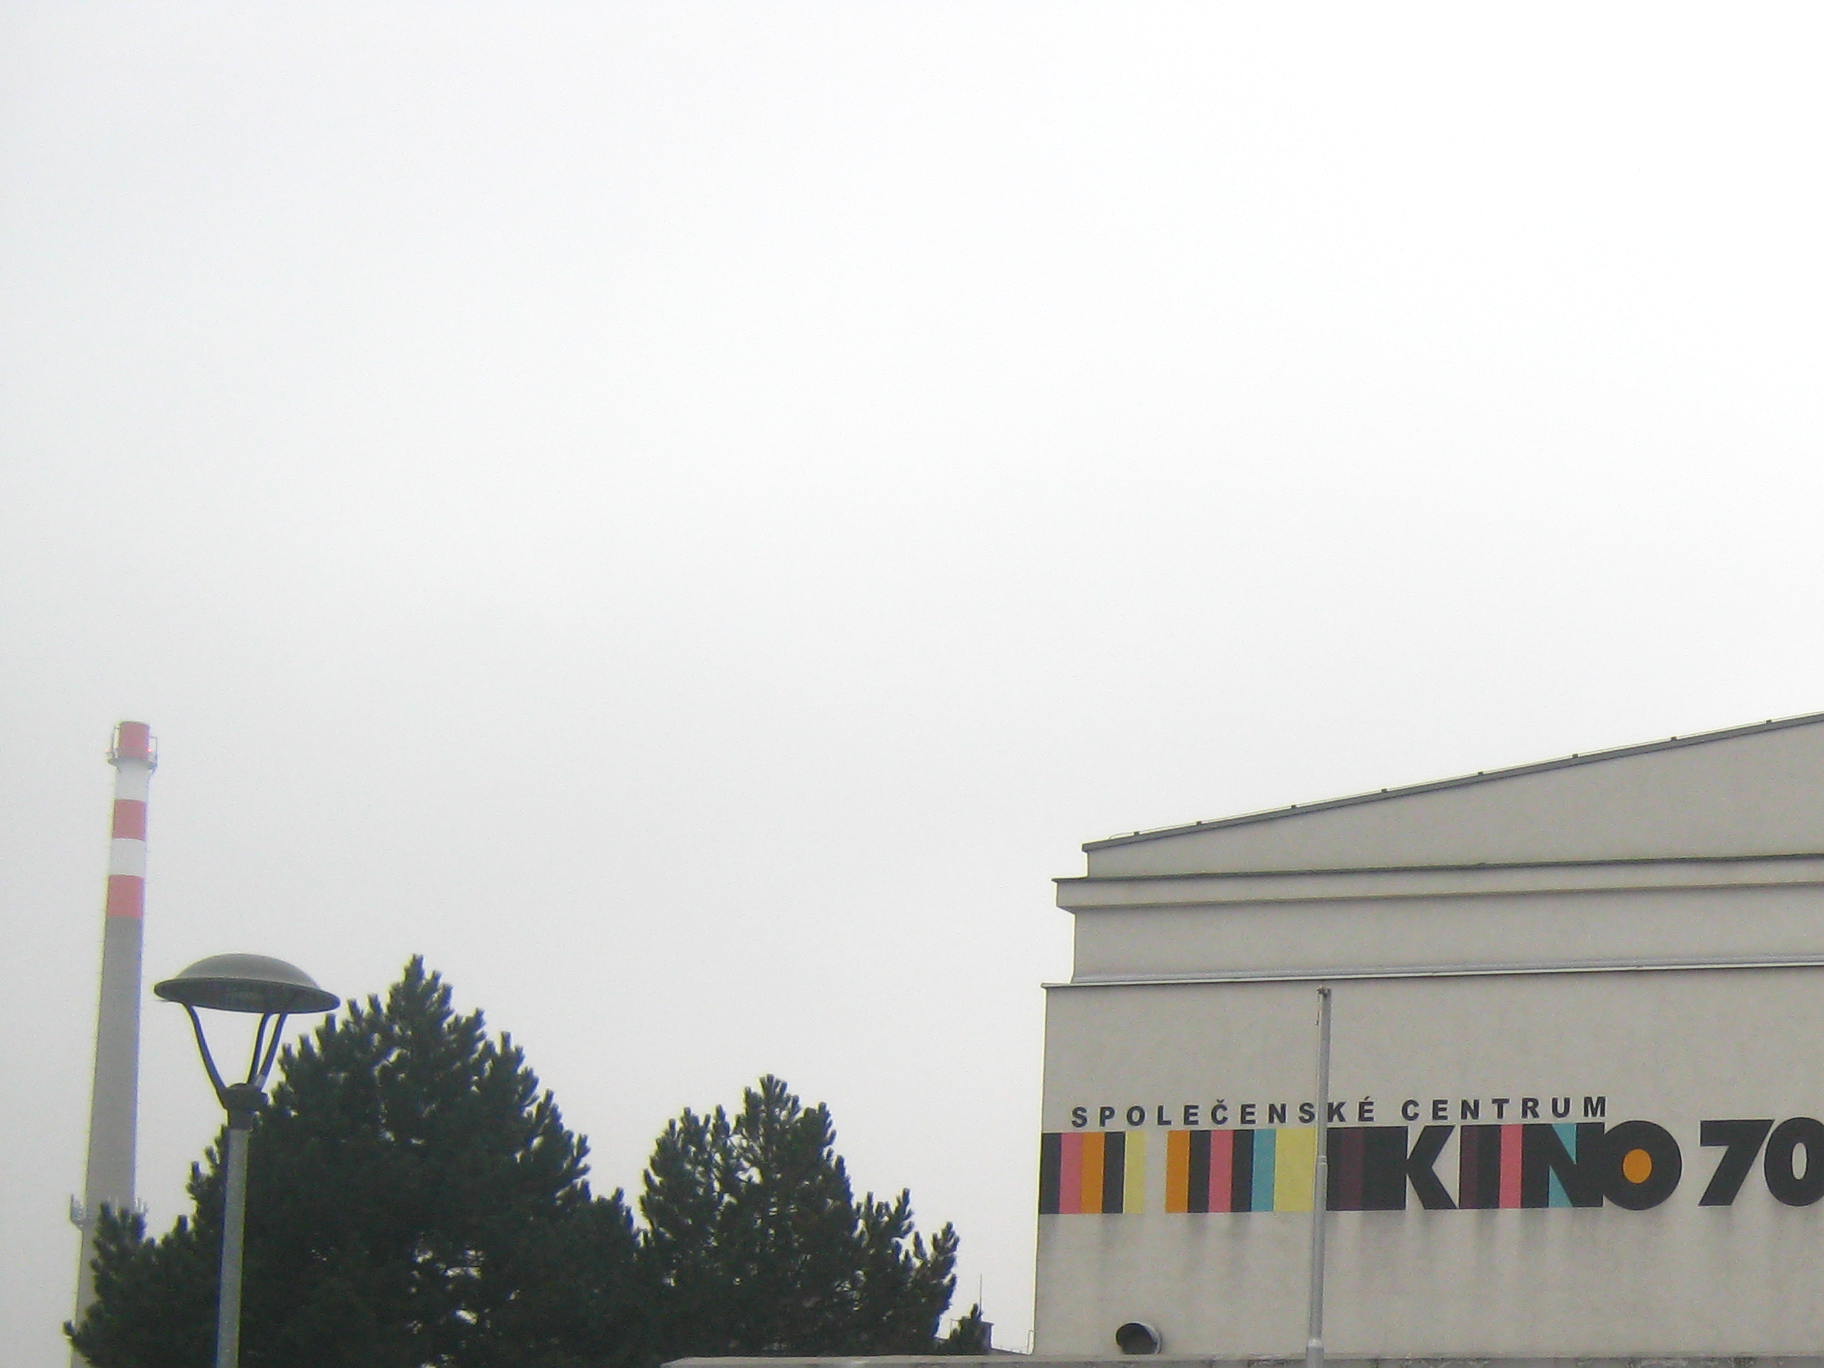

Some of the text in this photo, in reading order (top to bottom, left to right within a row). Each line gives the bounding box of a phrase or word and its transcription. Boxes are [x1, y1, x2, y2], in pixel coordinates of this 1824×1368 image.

[1072, 1096, 1607, 1128] SPOLEČENSKÉ CENTRUM
[1328, 1119, 1682, 1211] KINO
